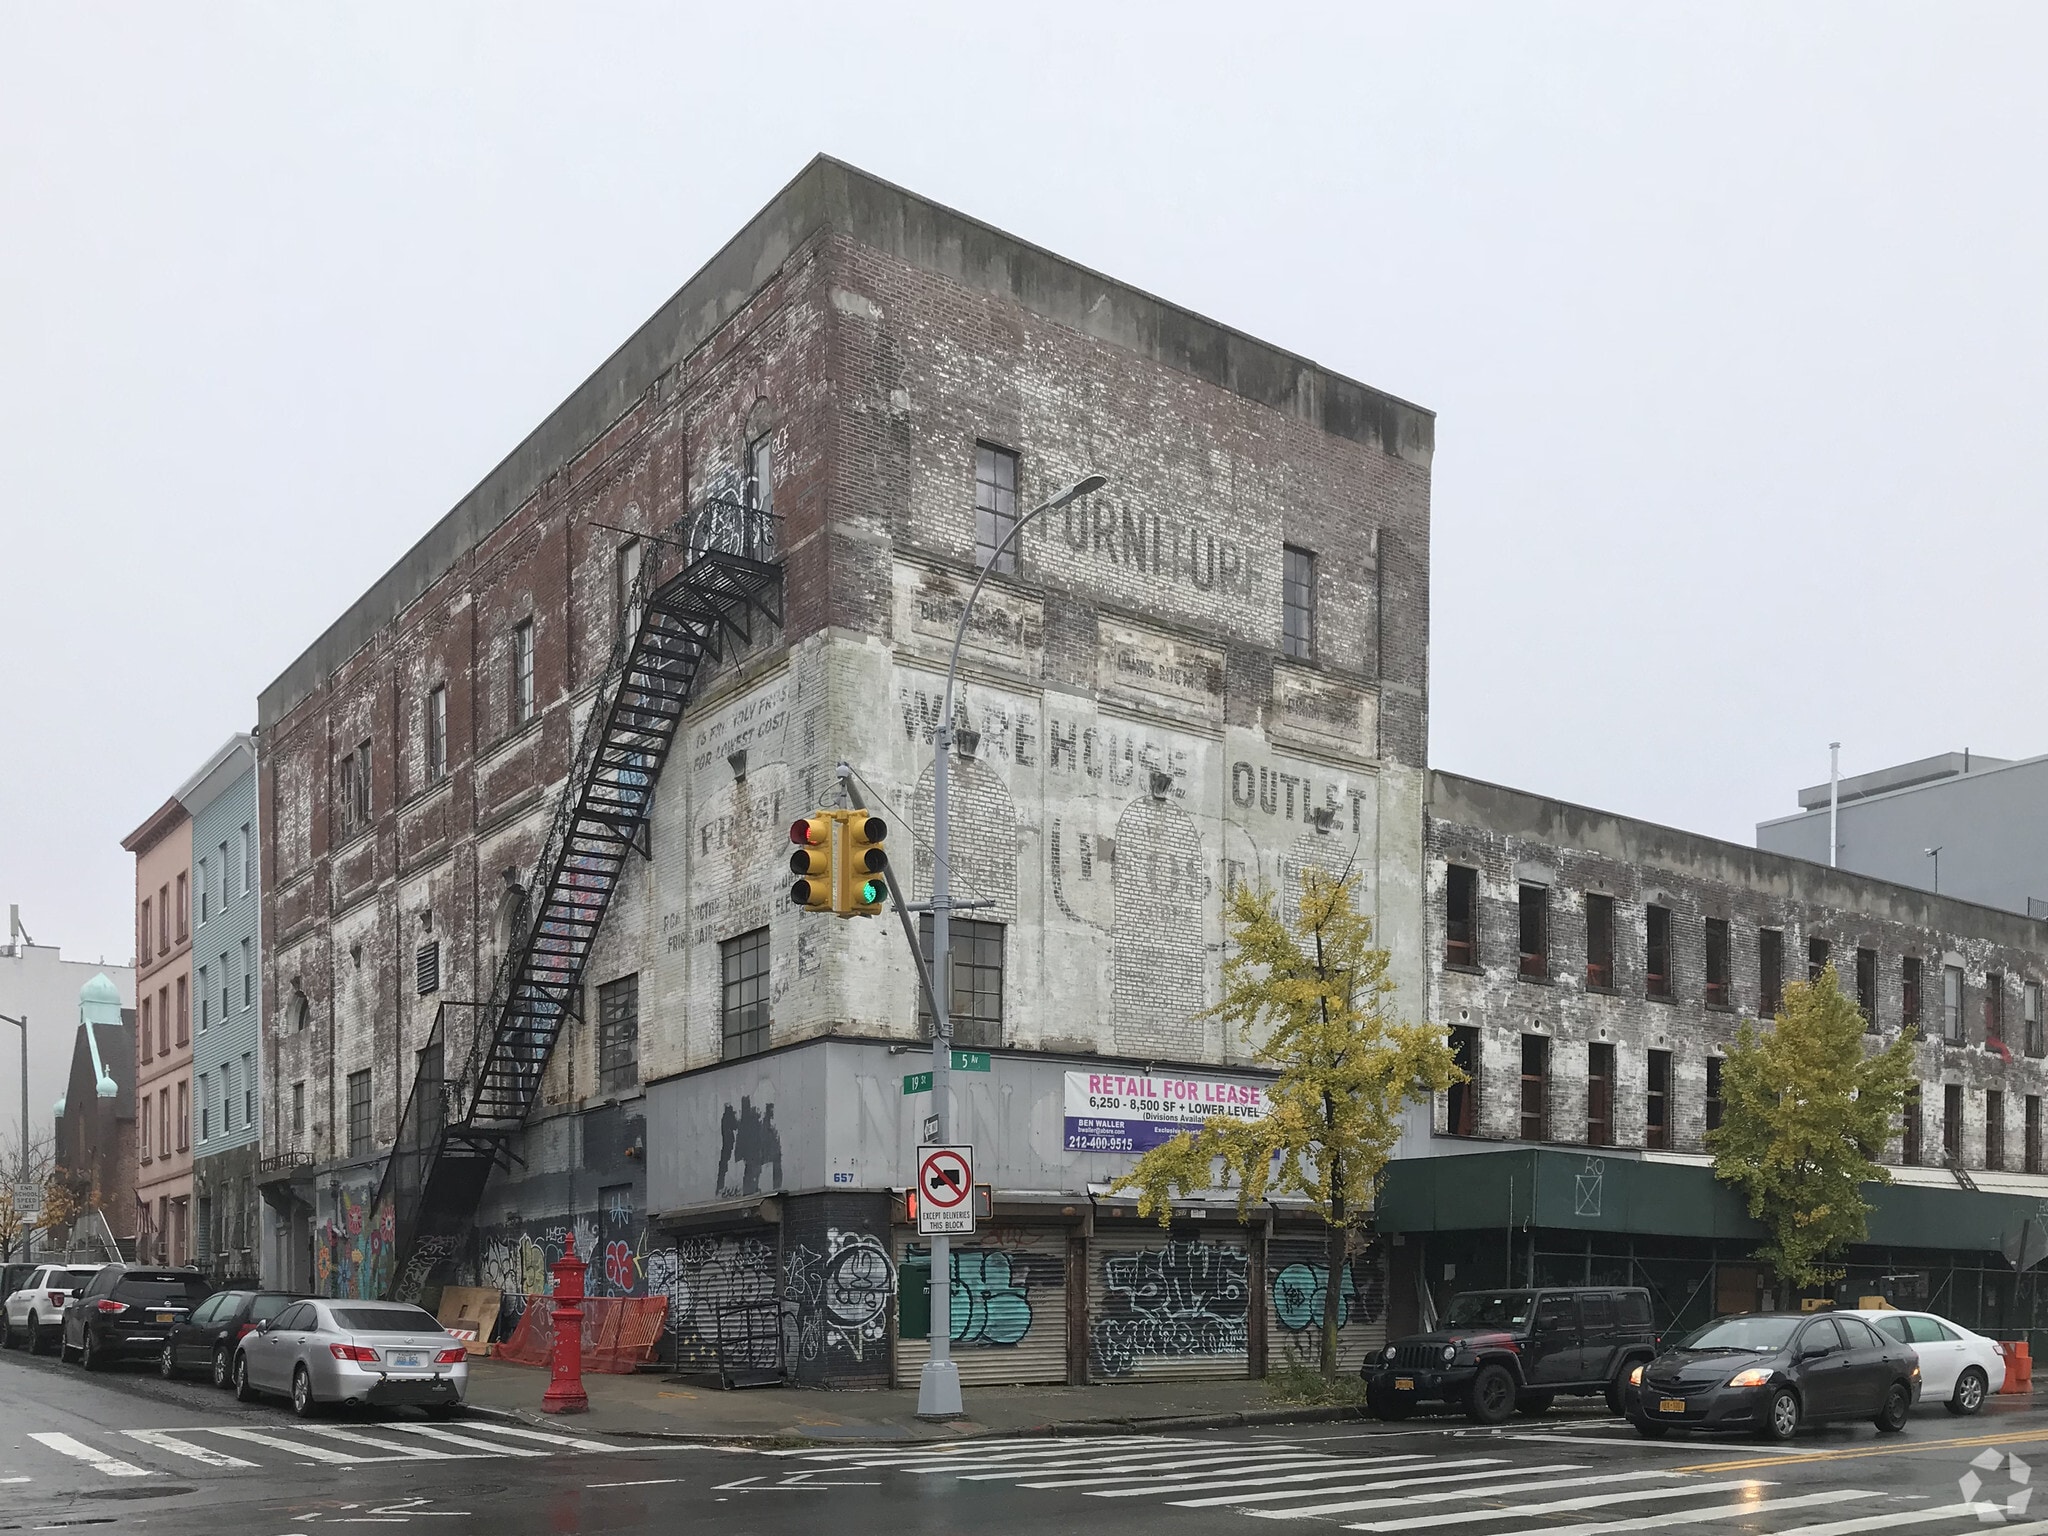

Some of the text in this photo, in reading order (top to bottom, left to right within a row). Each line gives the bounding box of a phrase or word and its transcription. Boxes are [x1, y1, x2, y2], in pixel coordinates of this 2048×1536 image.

[962, 1054, 978, 1069] 5 Av
[912, 1076, 919, 1091] 19
[1089, 1075, 1261, 1105] RETAIL FOR LEASE
[1089, 1096, 1120, 1110] 6,250
[1130, 1101, 1160, 1112] 8,500
[1163, 1101, 1176, 1113] SF
[1189, 1103, 1225, 1116] LOWER
[1228, 1106, 1260, 1118] LEVEL
[1078, 1119, 1125, 1128] BEN WALLER
[1069, 1135, 1133, 1150] 212-400-9515
[833, 1173, 854, 1183] 657
[923, 1210, 970, 1220] EXCEPT DELIVERIES
[930, 1221, 964, 1230] THIS BLOCK
